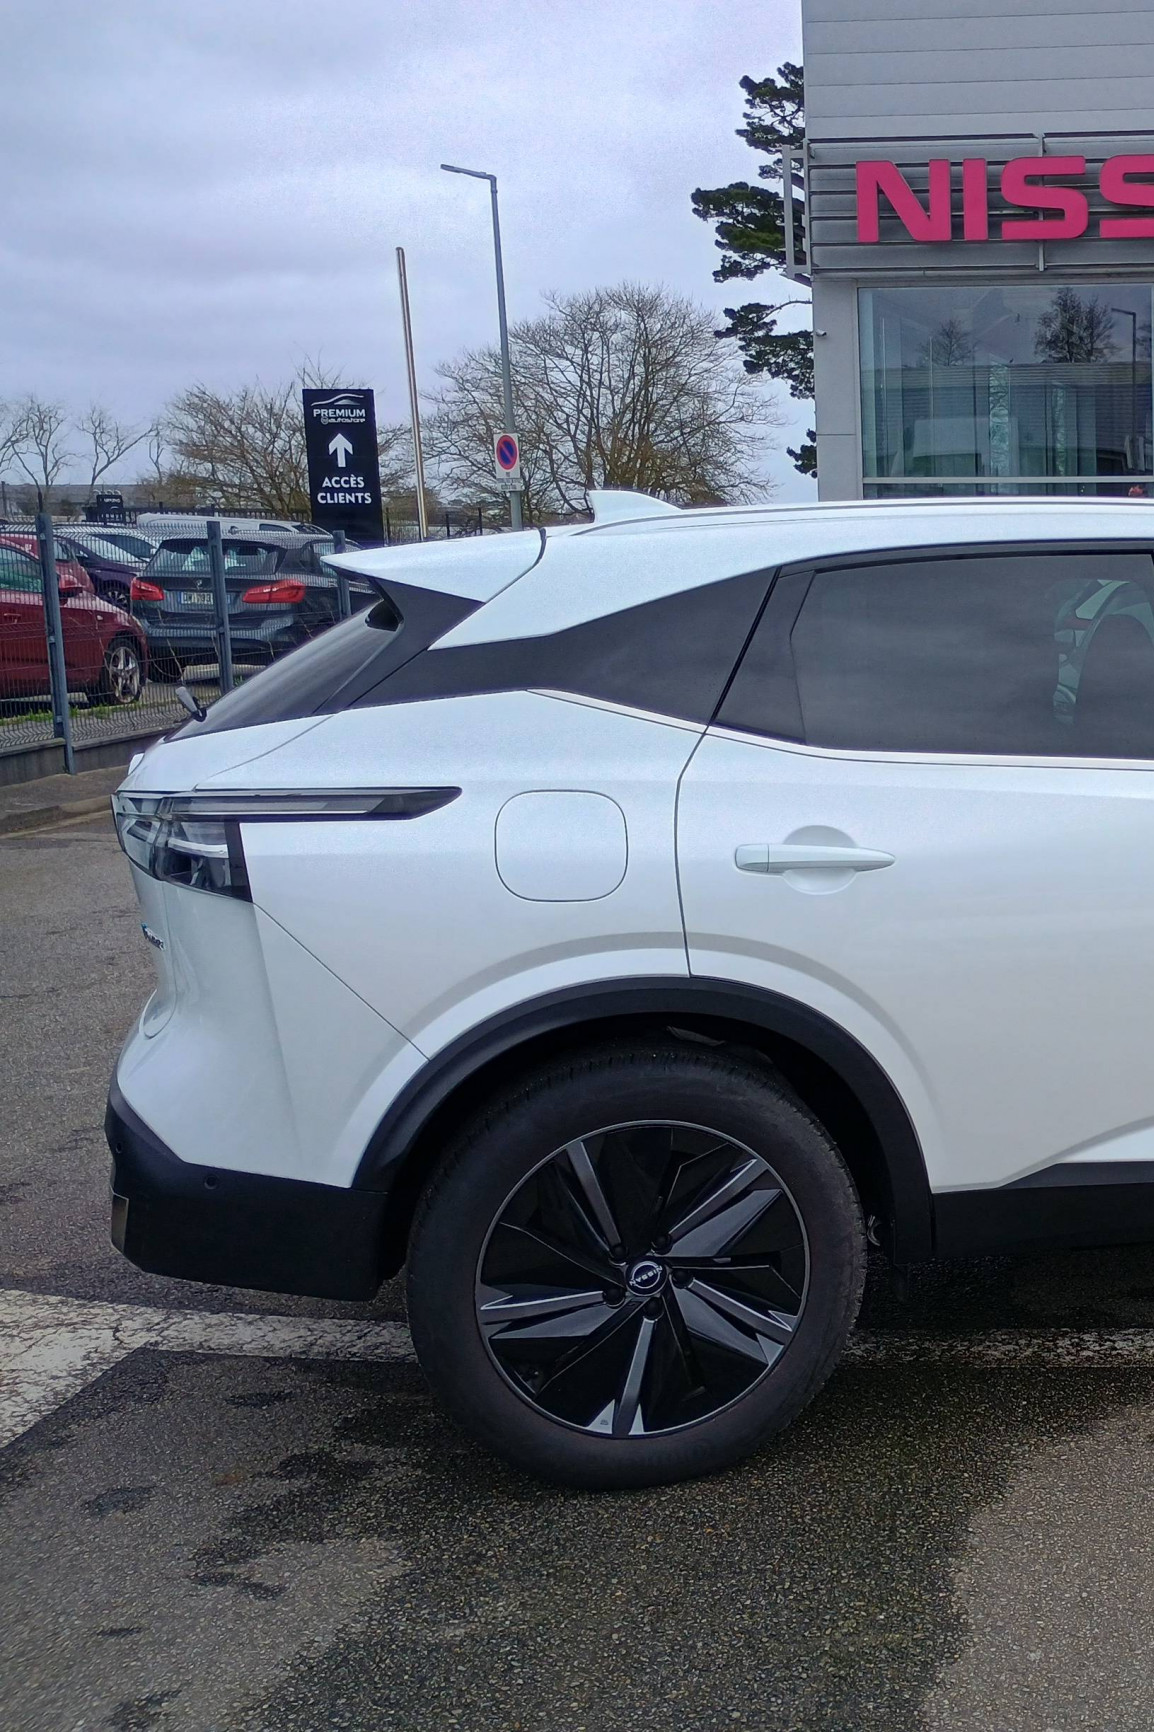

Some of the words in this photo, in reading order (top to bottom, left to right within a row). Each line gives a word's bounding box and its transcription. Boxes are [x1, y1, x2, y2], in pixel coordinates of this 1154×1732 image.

[313, 408, 366, 417] PREMIUM
[322, 474, 365, 488] ACCÈS
[317, 492, 372, 504] CLIENTS
[629, 1265, 663, 1286] NISSAN
